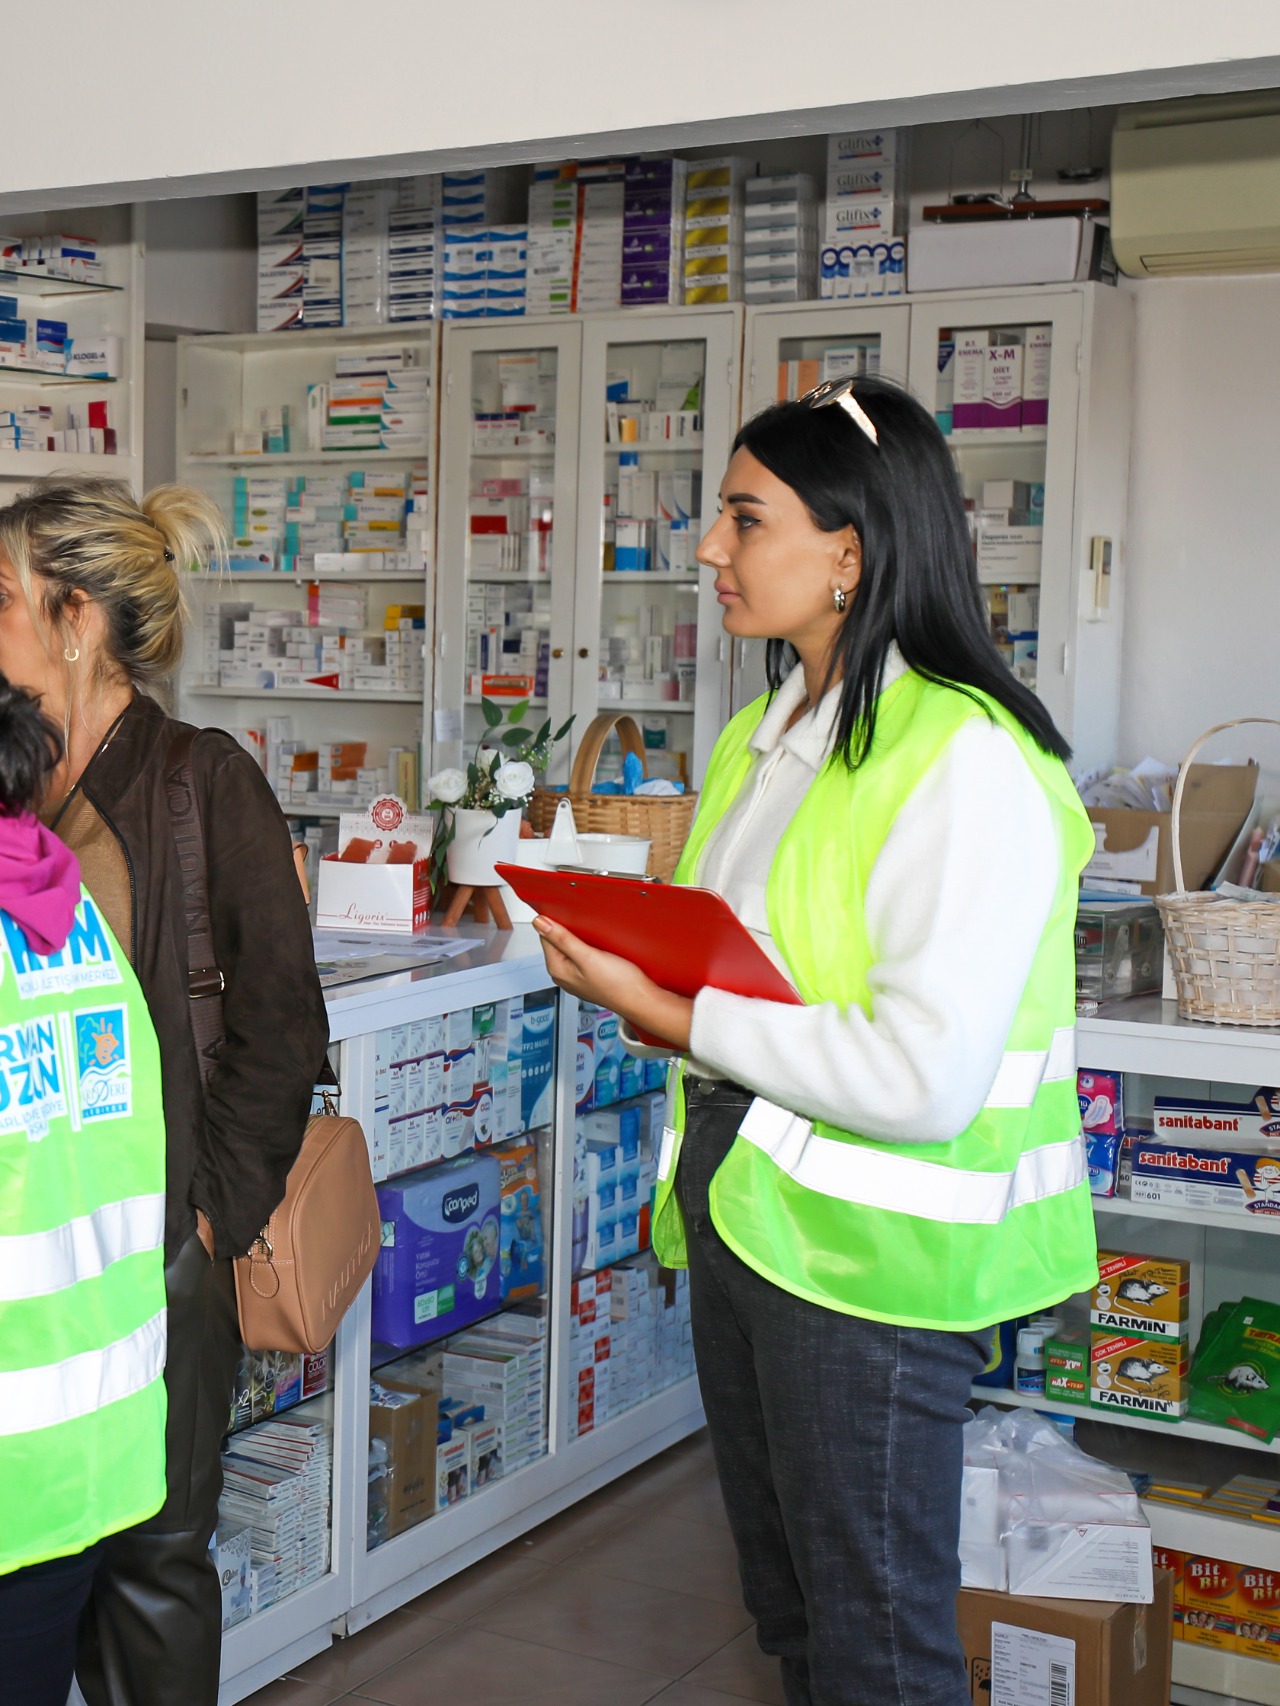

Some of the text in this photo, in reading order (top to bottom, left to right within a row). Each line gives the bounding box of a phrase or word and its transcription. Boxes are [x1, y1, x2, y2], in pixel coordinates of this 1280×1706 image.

[836, 210, 872, 222] Glifix
[338, 903, 388, 925] Ligorix
[1159, 1115, 1239, 1131] sanitabant
[1138, 1152, 1228, 1174] sanitabant
[1147, 1192, 1161, 1200] 601
[1191, 1562, 1220, 1576] Bit
[1200, 1576, 1228, 1589] Bit
[1244, 1574, 1274, 1588] Bit
